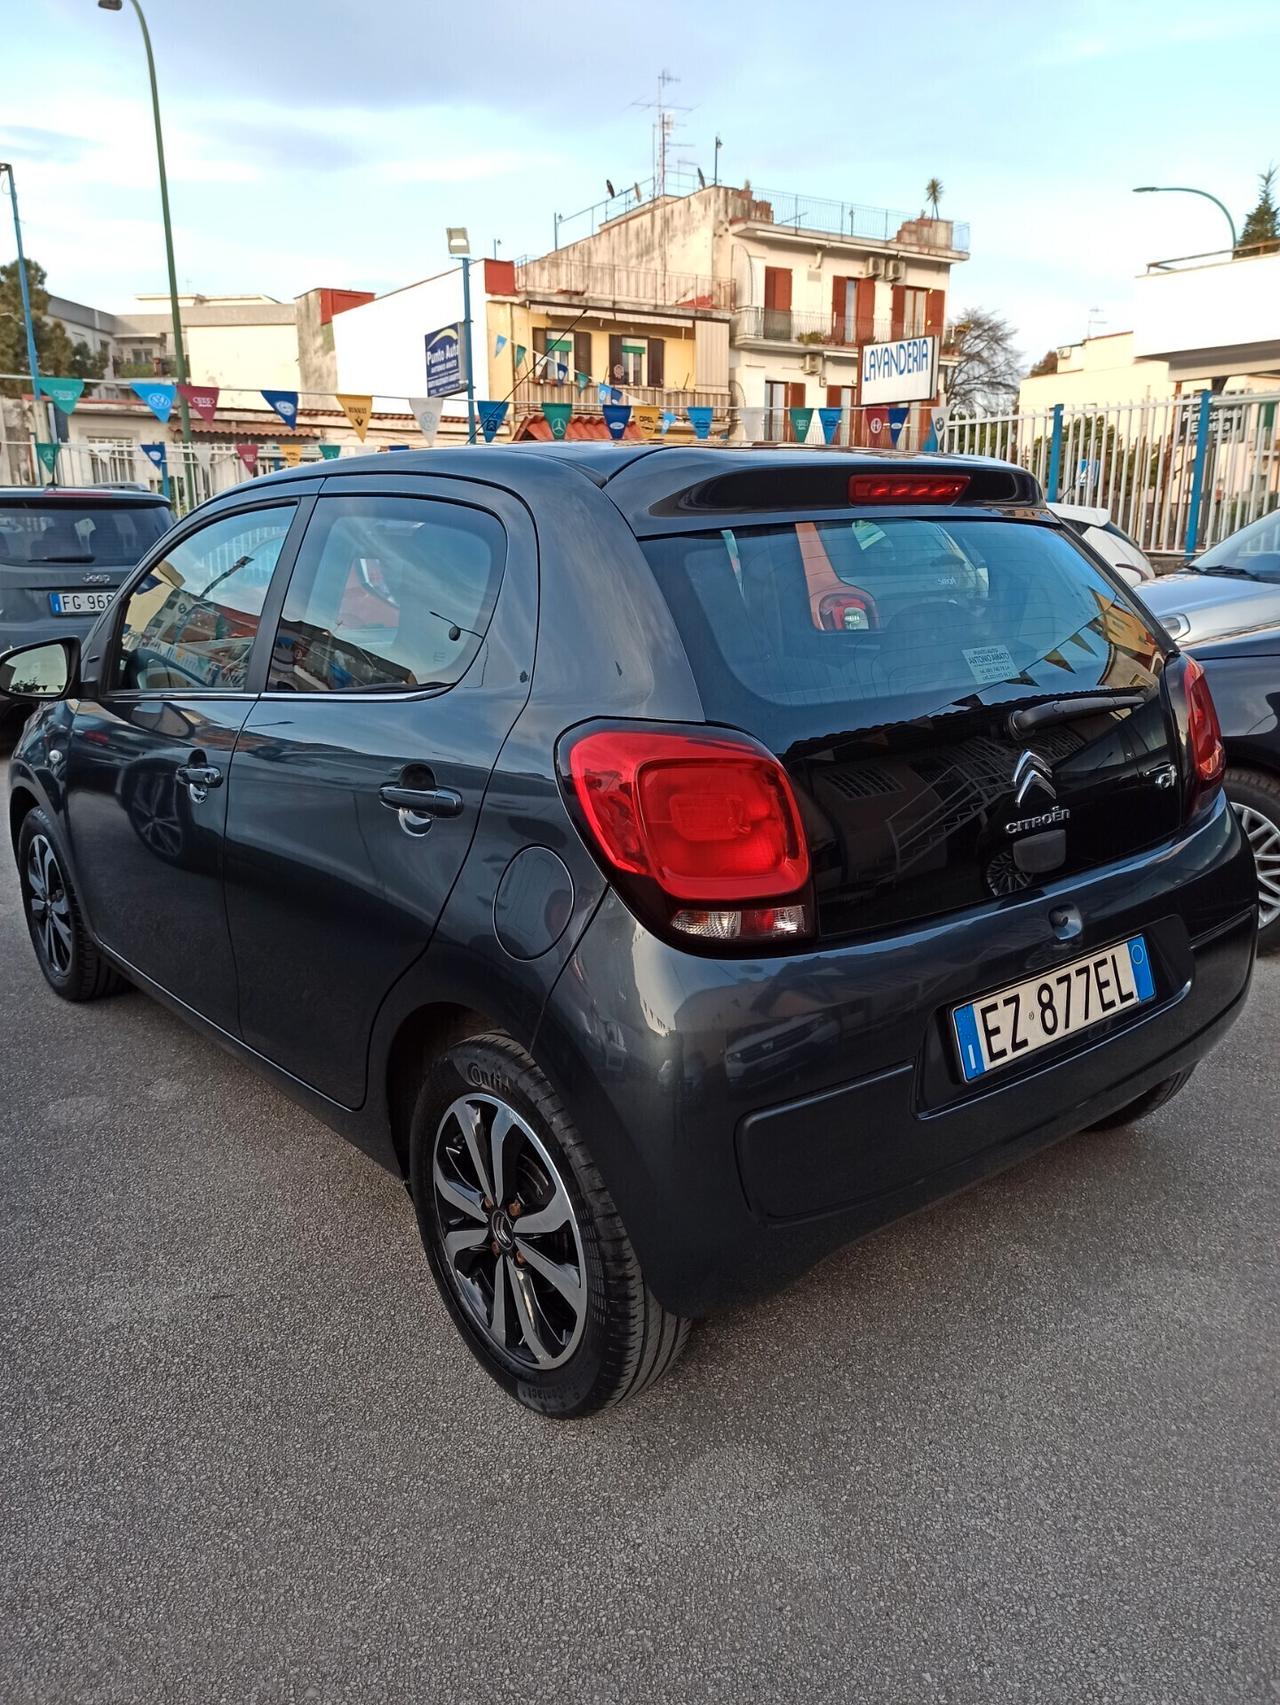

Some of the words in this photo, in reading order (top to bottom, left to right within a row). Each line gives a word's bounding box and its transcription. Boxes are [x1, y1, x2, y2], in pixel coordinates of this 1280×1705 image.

[427, 349, 444, 366] Punto
[864, 339, 928, 382] LAVANDERIA
[639, 415, 654, 423] OPEL
[82, 572, 110, 584] Jeep
[62, 595, 82, 611] FG
[980, 993, 1030, 1063] EZ
[1037, 954, 1134, 1037] 877EL
